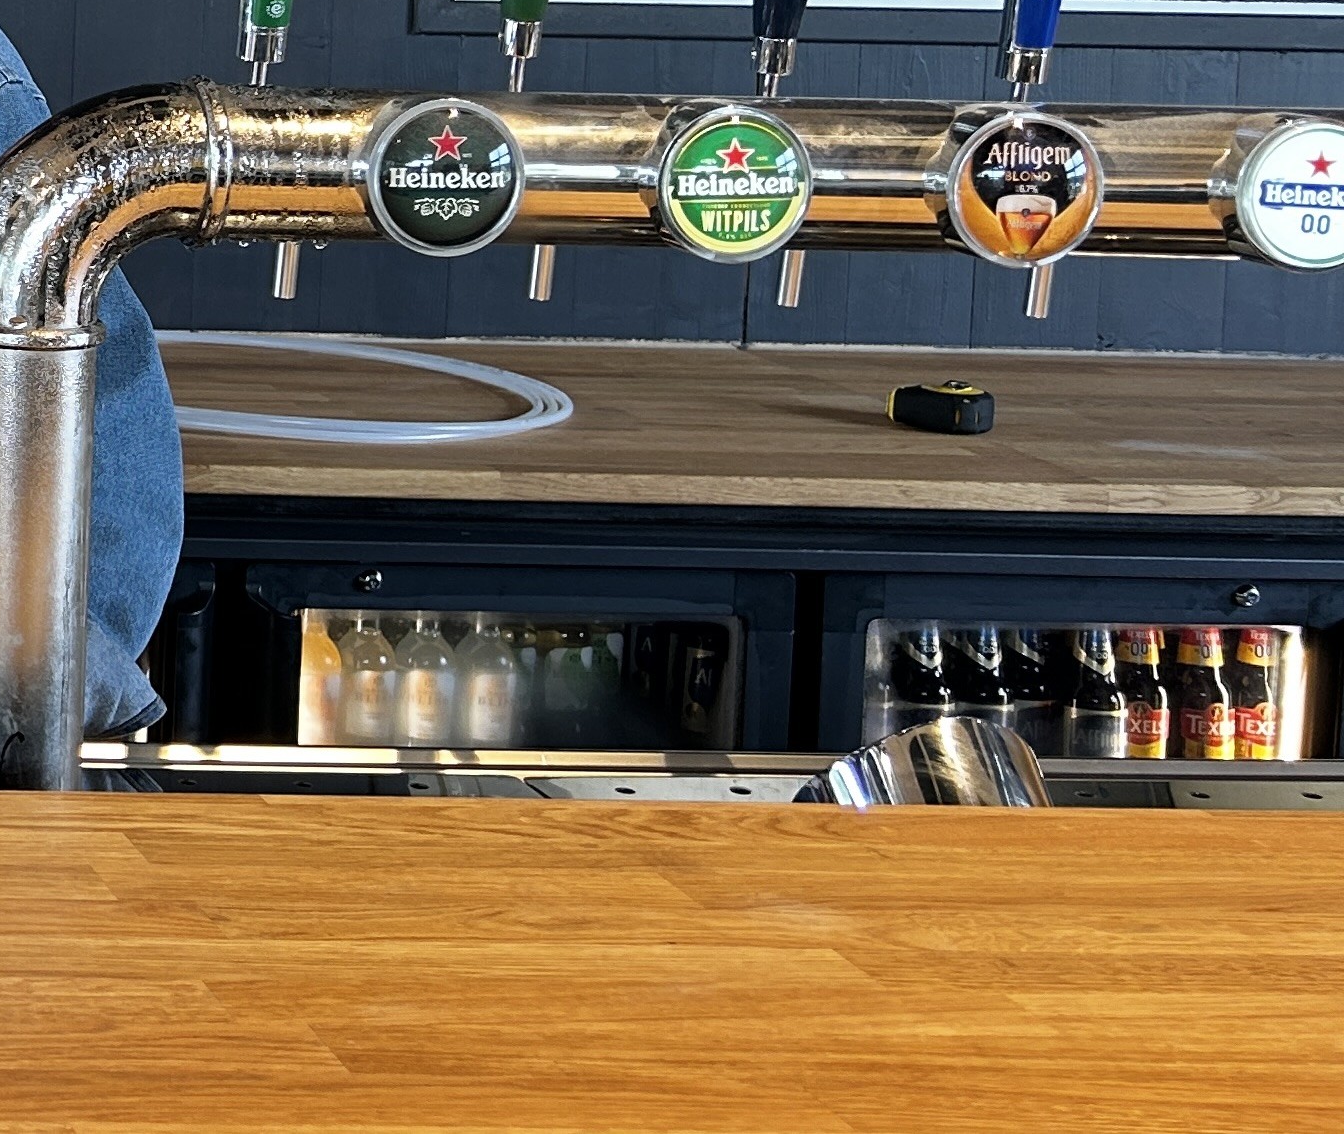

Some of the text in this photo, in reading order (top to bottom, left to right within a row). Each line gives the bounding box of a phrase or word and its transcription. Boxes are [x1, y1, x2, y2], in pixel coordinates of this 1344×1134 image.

[982, 141, 1071, 170] Affligem
[389, 165, 506, 189] Heineken
[677, 172, 795, 196] Heineken
[1004, 171, 1051, 182] BLOND
[1265, 184, 1344, 207] Heinek
[701, 209, 771, 232] WITPILS
